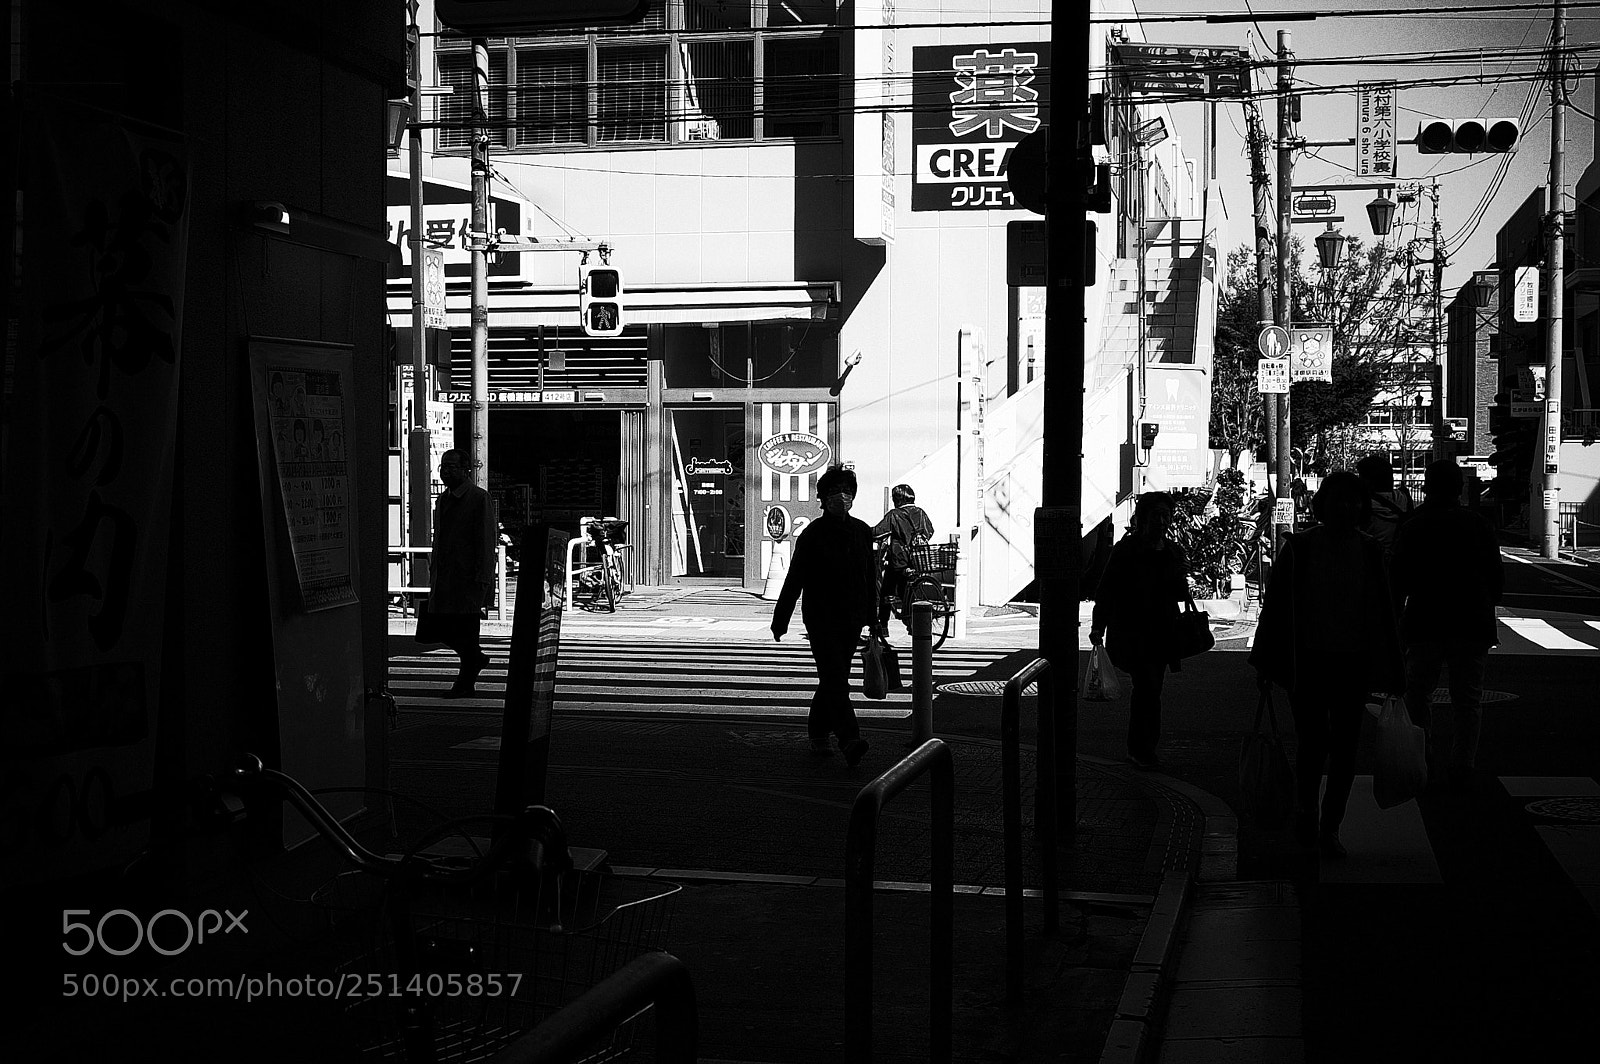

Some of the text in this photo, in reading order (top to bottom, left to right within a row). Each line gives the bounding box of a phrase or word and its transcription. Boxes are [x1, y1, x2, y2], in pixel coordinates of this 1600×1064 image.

[948, 48, 1041, 139] 薬
[1361, 126, 1371, 134] 6
[1361, 137, 1371, 155] sho
[1361, 158, 1369, 175] ura
